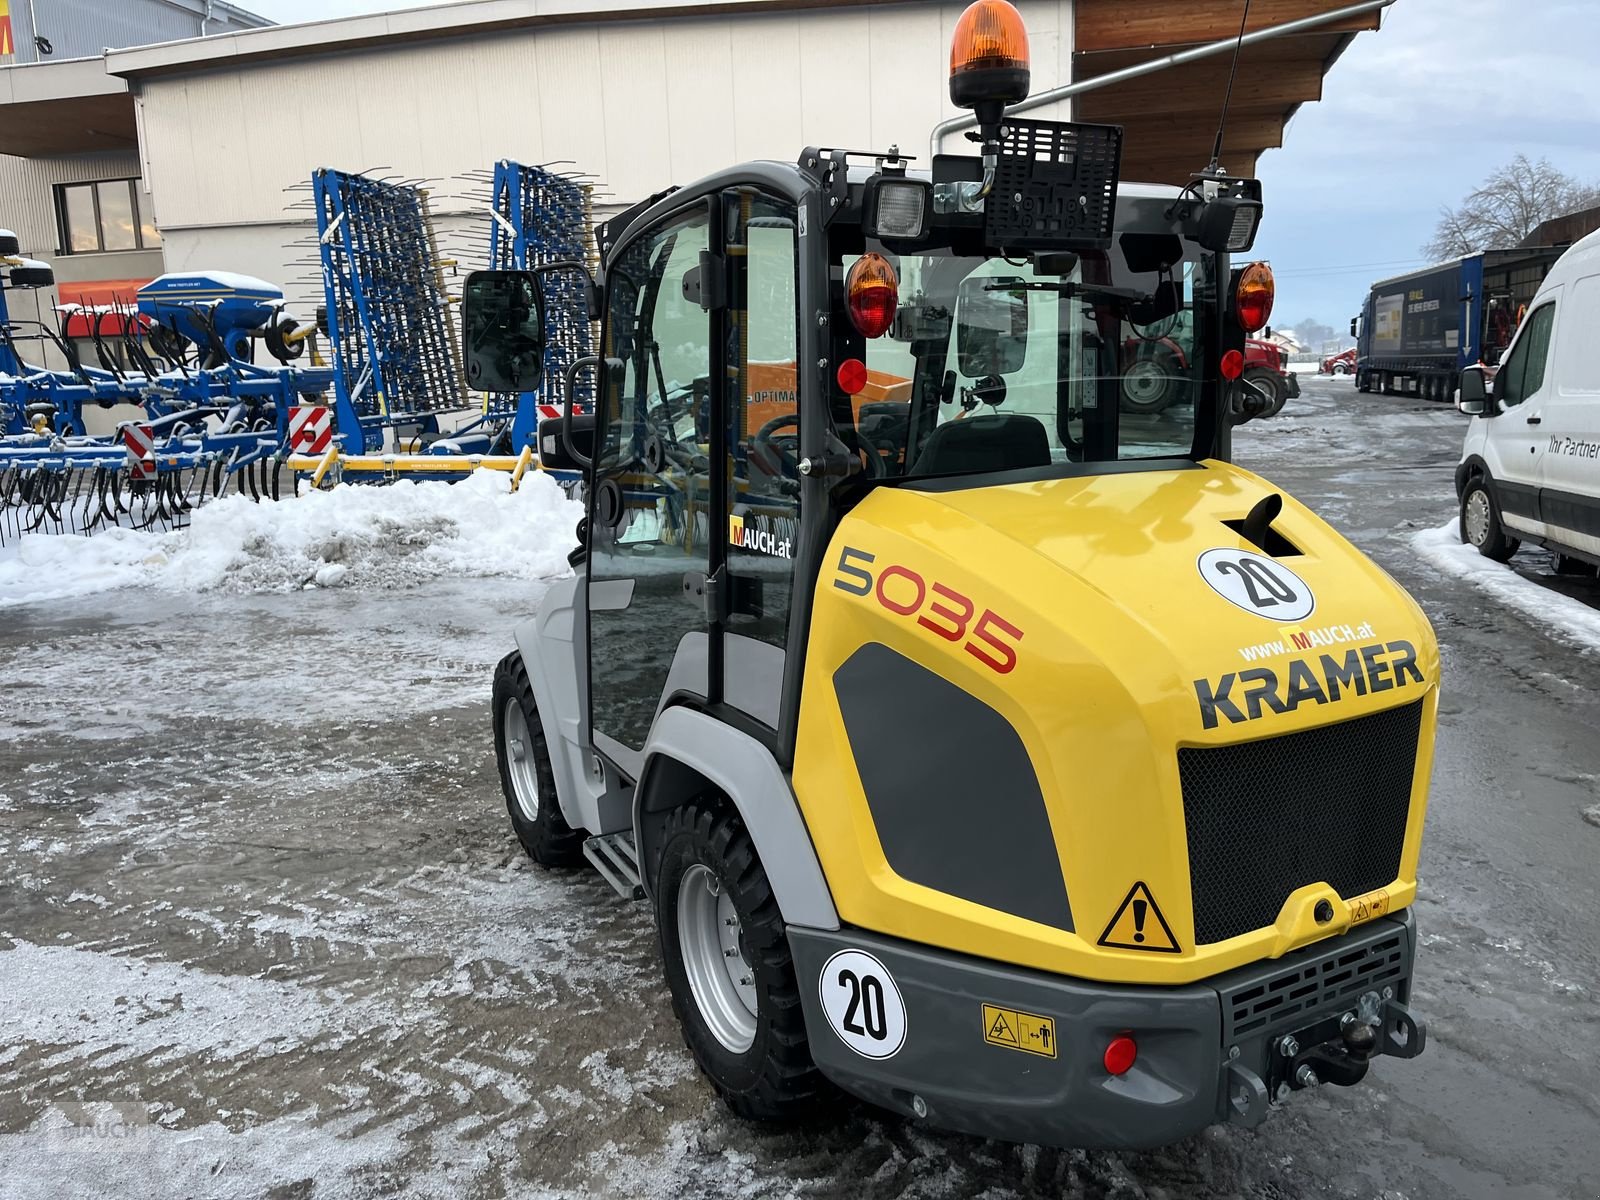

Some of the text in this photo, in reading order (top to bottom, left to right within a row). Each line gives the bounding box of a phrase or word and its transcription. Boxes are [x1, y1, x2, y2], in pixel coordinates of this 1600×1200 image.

[1548, 434, 1600, 459] Ihr Partner
[733, 525, 791, 559] MAUCH.at
[1215, 558, 1298, 608] 20
[833, 545, 1024, 674] 5035
[1239, 621, 1376, 662] www.MAUCH.at
[1193, 640, 1425, 730] KRAMER
[838, 969, 888, 1041] 20
